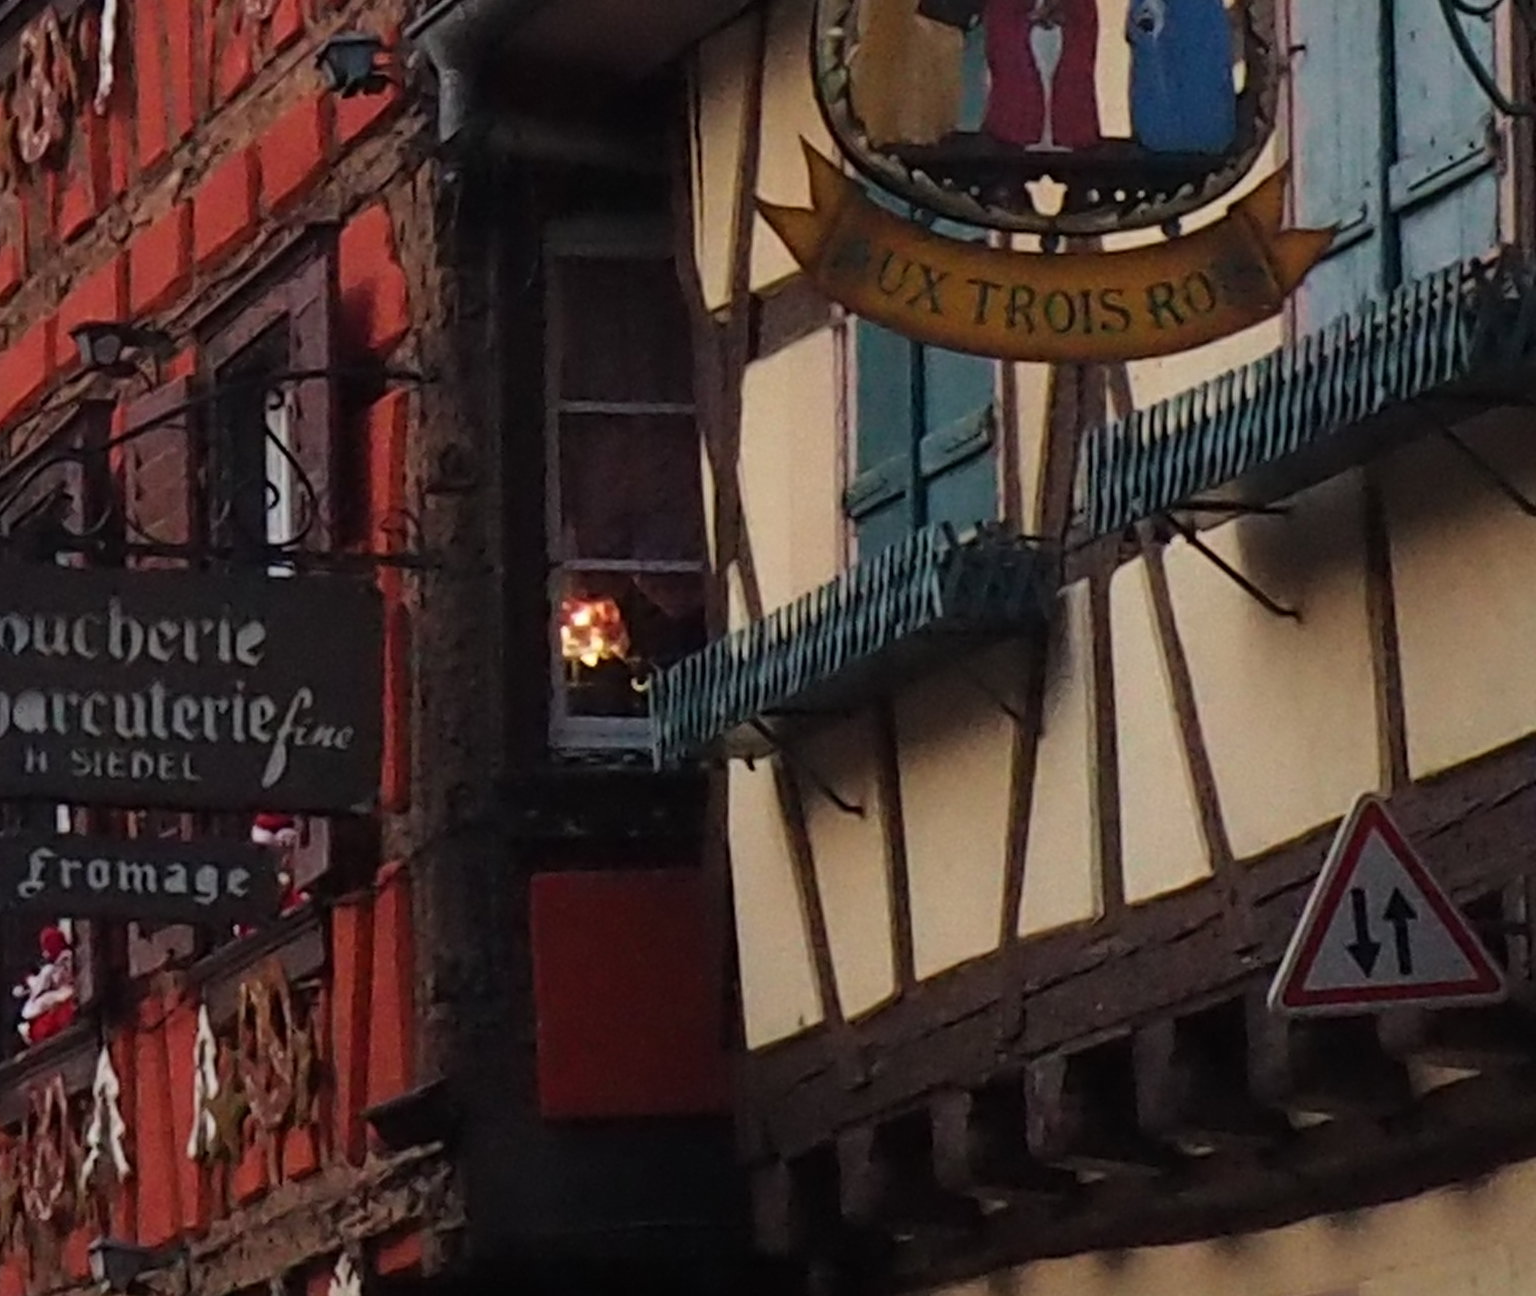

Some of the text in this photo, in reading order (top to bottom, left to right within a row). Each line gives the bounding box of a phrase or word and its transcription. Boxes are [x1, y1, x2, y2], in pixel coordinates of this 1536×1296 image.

[833, 240, 1254, 336] UX TROIS RO
[69, 748, 203, 782] SIEDEL
[260, 686, 355, 789] fine
[18, 846, 252, 905] Fromage
